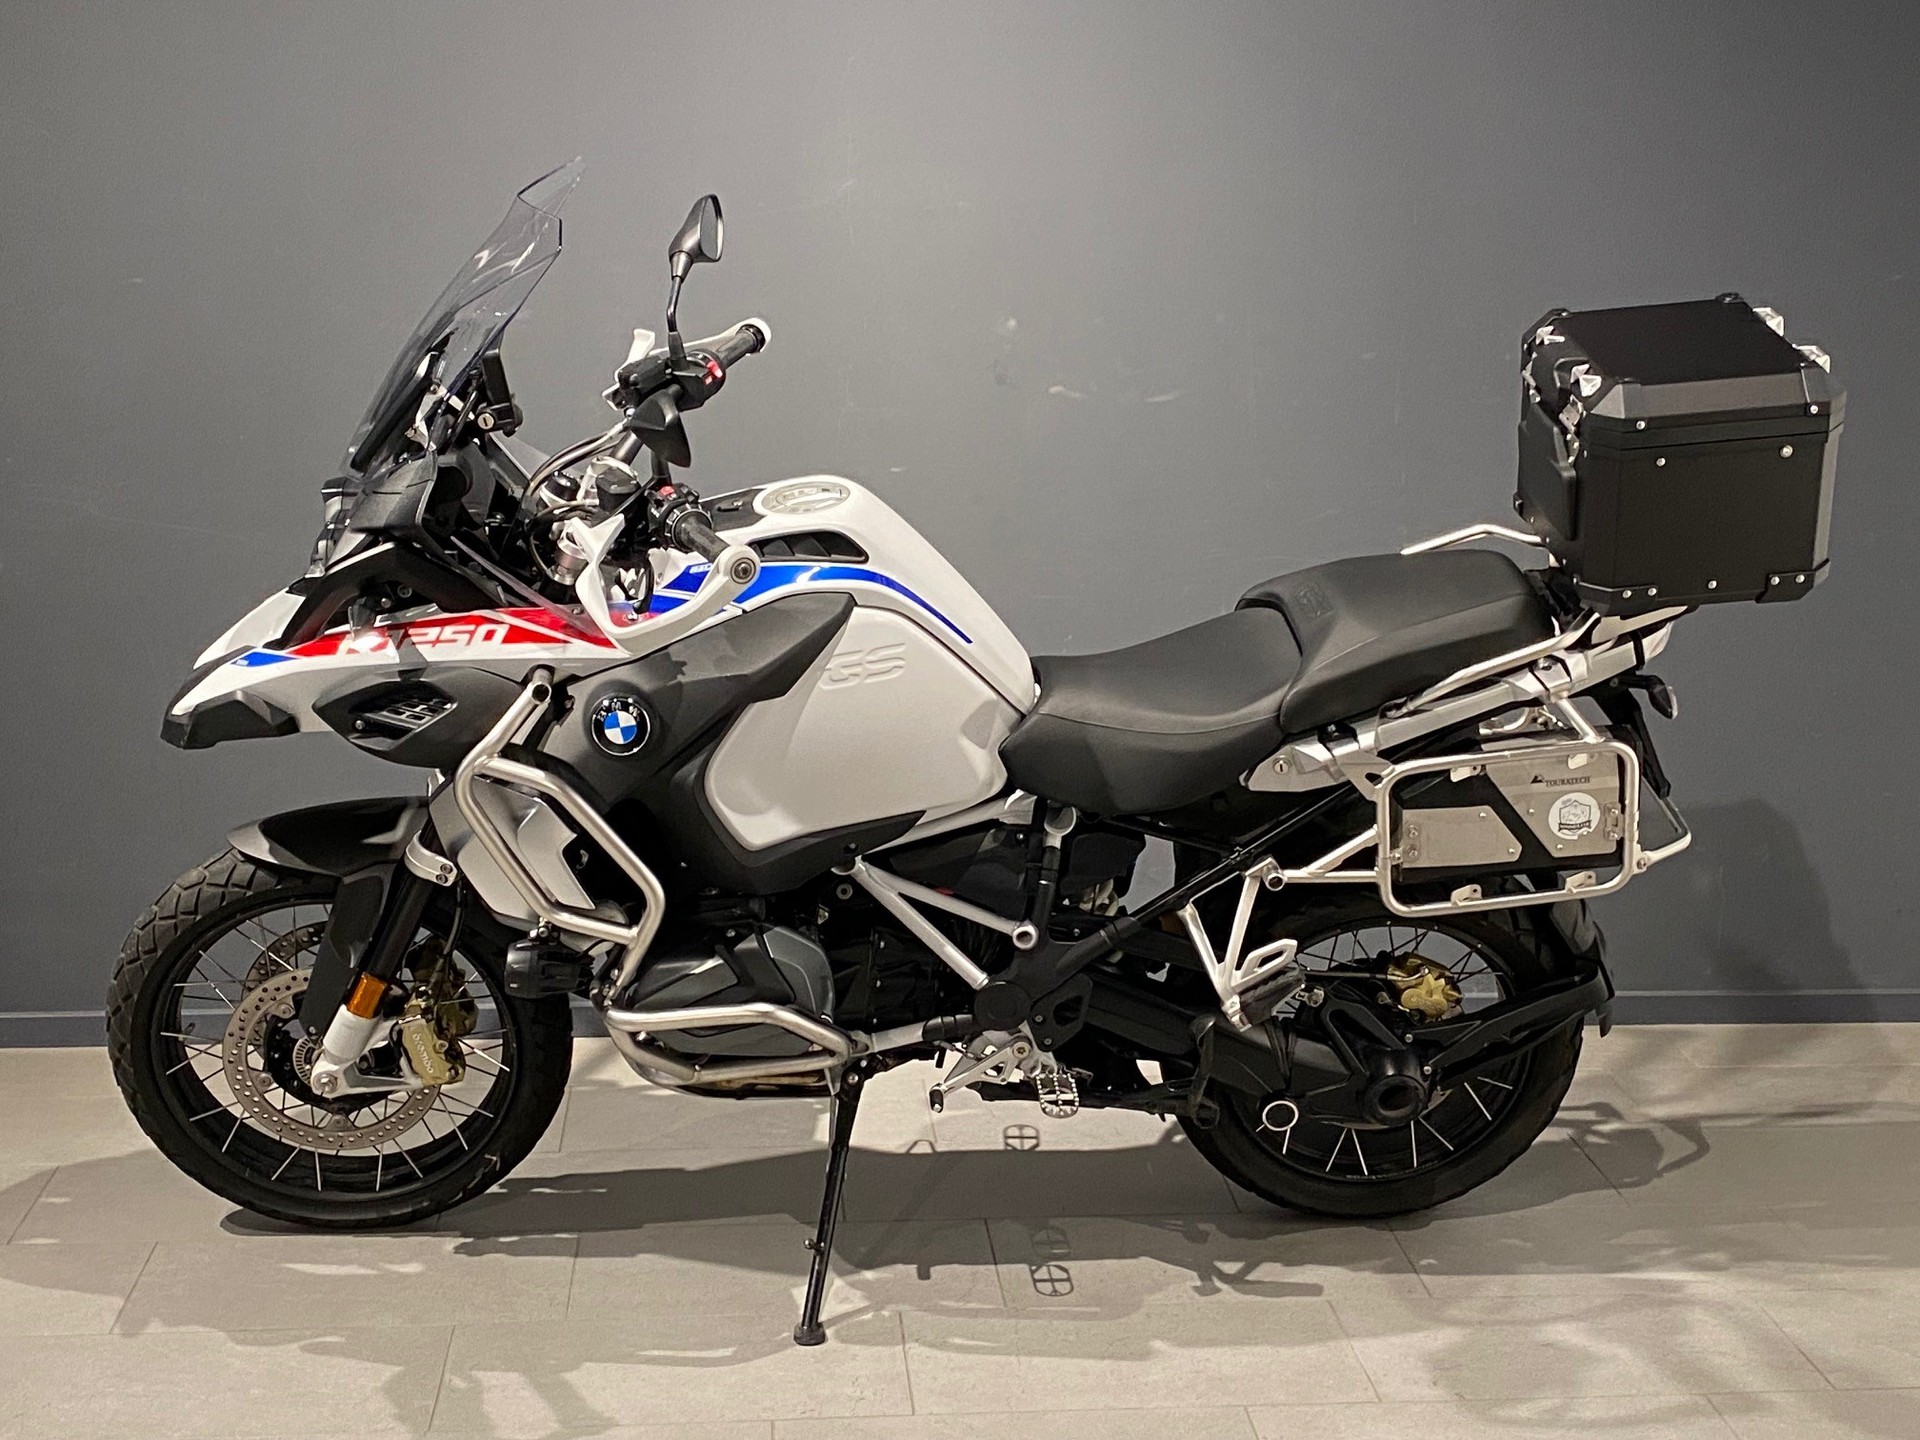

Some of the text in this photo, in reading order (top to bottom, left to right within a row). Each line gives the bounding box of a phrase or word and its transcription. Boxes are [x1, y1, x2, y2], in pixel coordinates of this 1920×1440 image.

[820, 643, 906, 690] GS
[597, 701, 640, 721] BMW
[1545, 776, 1590, 787] TOURATECH
